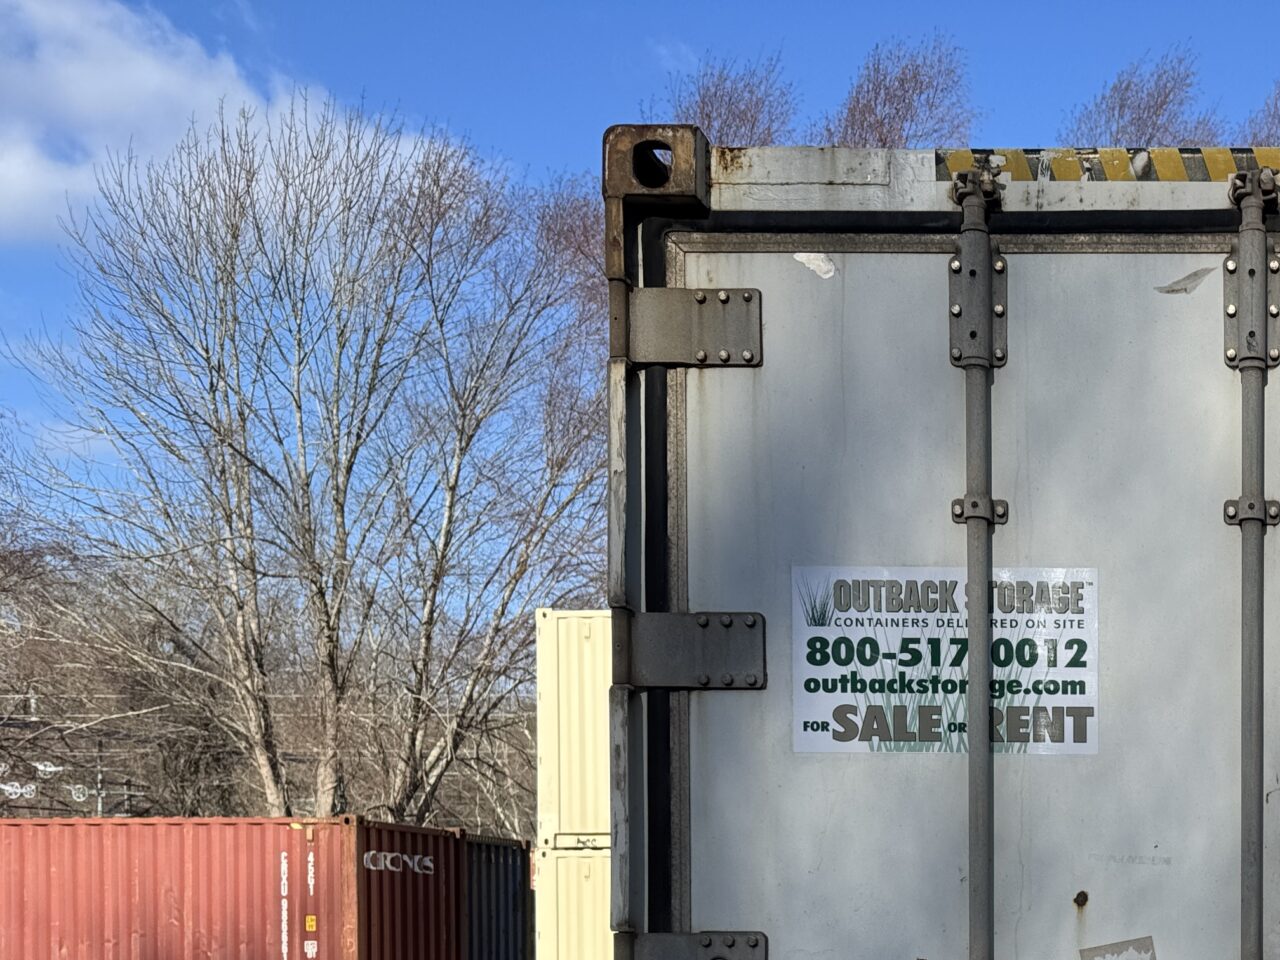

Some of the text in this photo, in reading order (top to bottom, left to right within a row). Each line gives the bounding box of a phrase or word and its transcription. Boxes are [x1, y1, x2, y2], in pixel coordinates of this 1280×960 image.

[833, 579, 959, 613] OUTBACK
[834, 617, 1085, 629] CONTAINERS DELIRED ON SITE
[803, 671, 1087, 699] outbackstorge.com
[803, 704, 1095, 743] FOR SALE OR RENT
